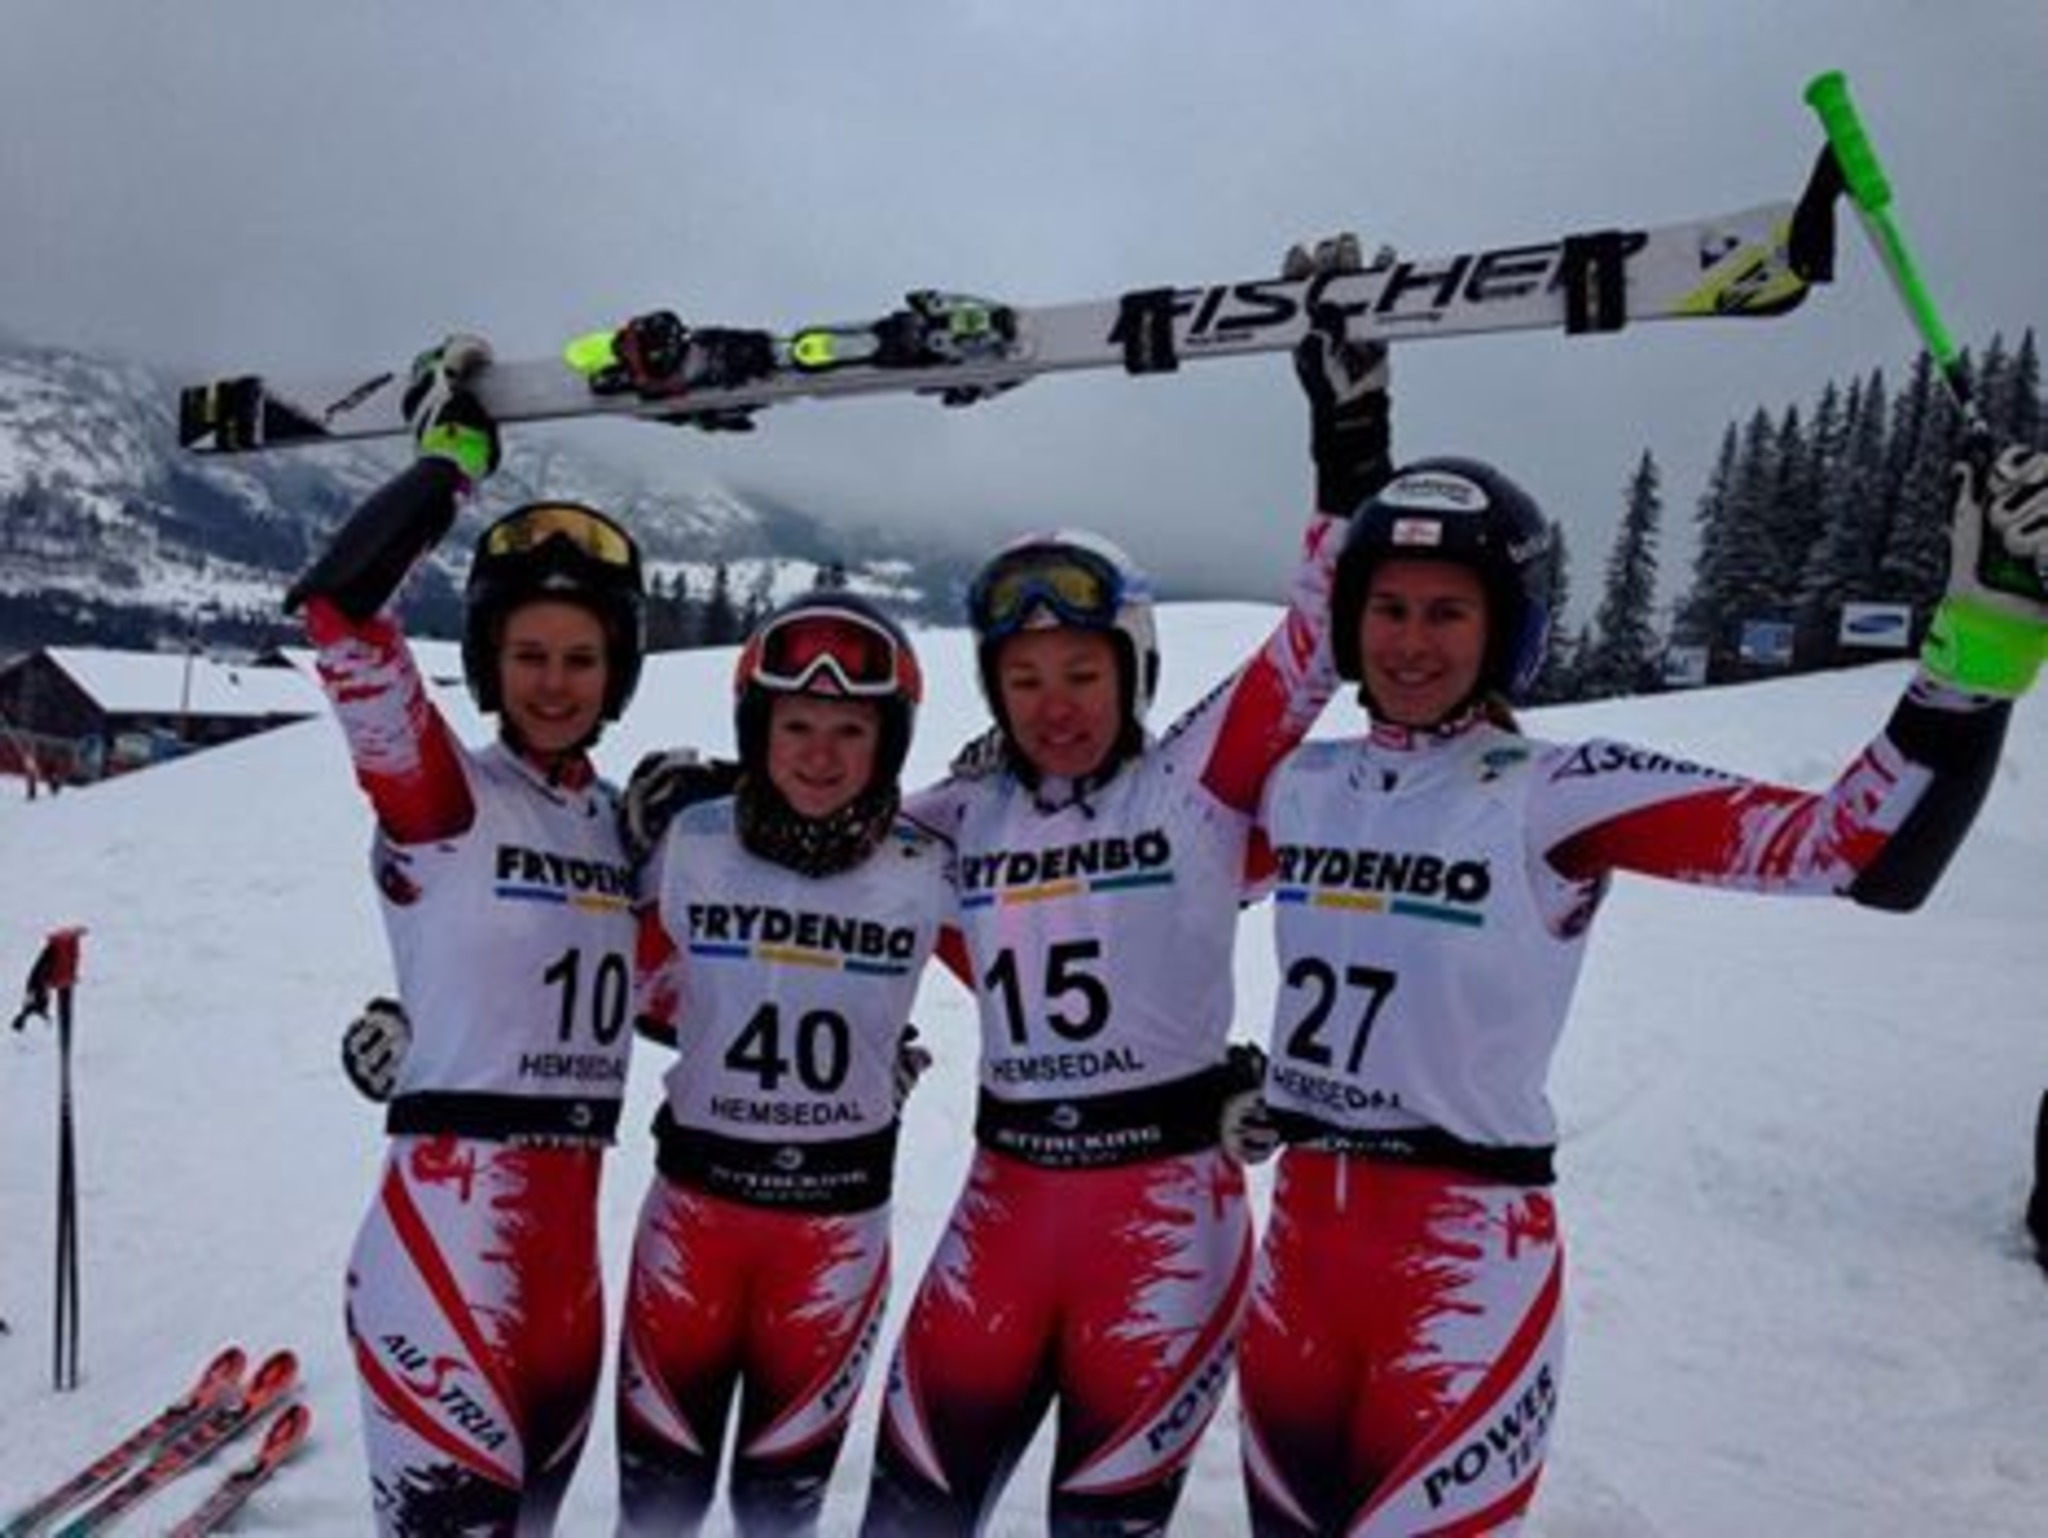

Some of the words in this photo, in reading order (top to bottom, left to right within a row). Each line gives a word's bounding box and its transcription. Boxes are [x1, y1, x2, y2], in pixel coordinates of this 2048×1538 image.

[544, 948, 630, 1046] 10
[984, 939, 1111, 1044] 15
[1286, 956, 1398, 1074] 27
[724, 1001, 850, 1094] 40
[711, 1096, 864, 1126] HEMSEDAL
[379, 1333, 508, 1450] AUSTRIA
